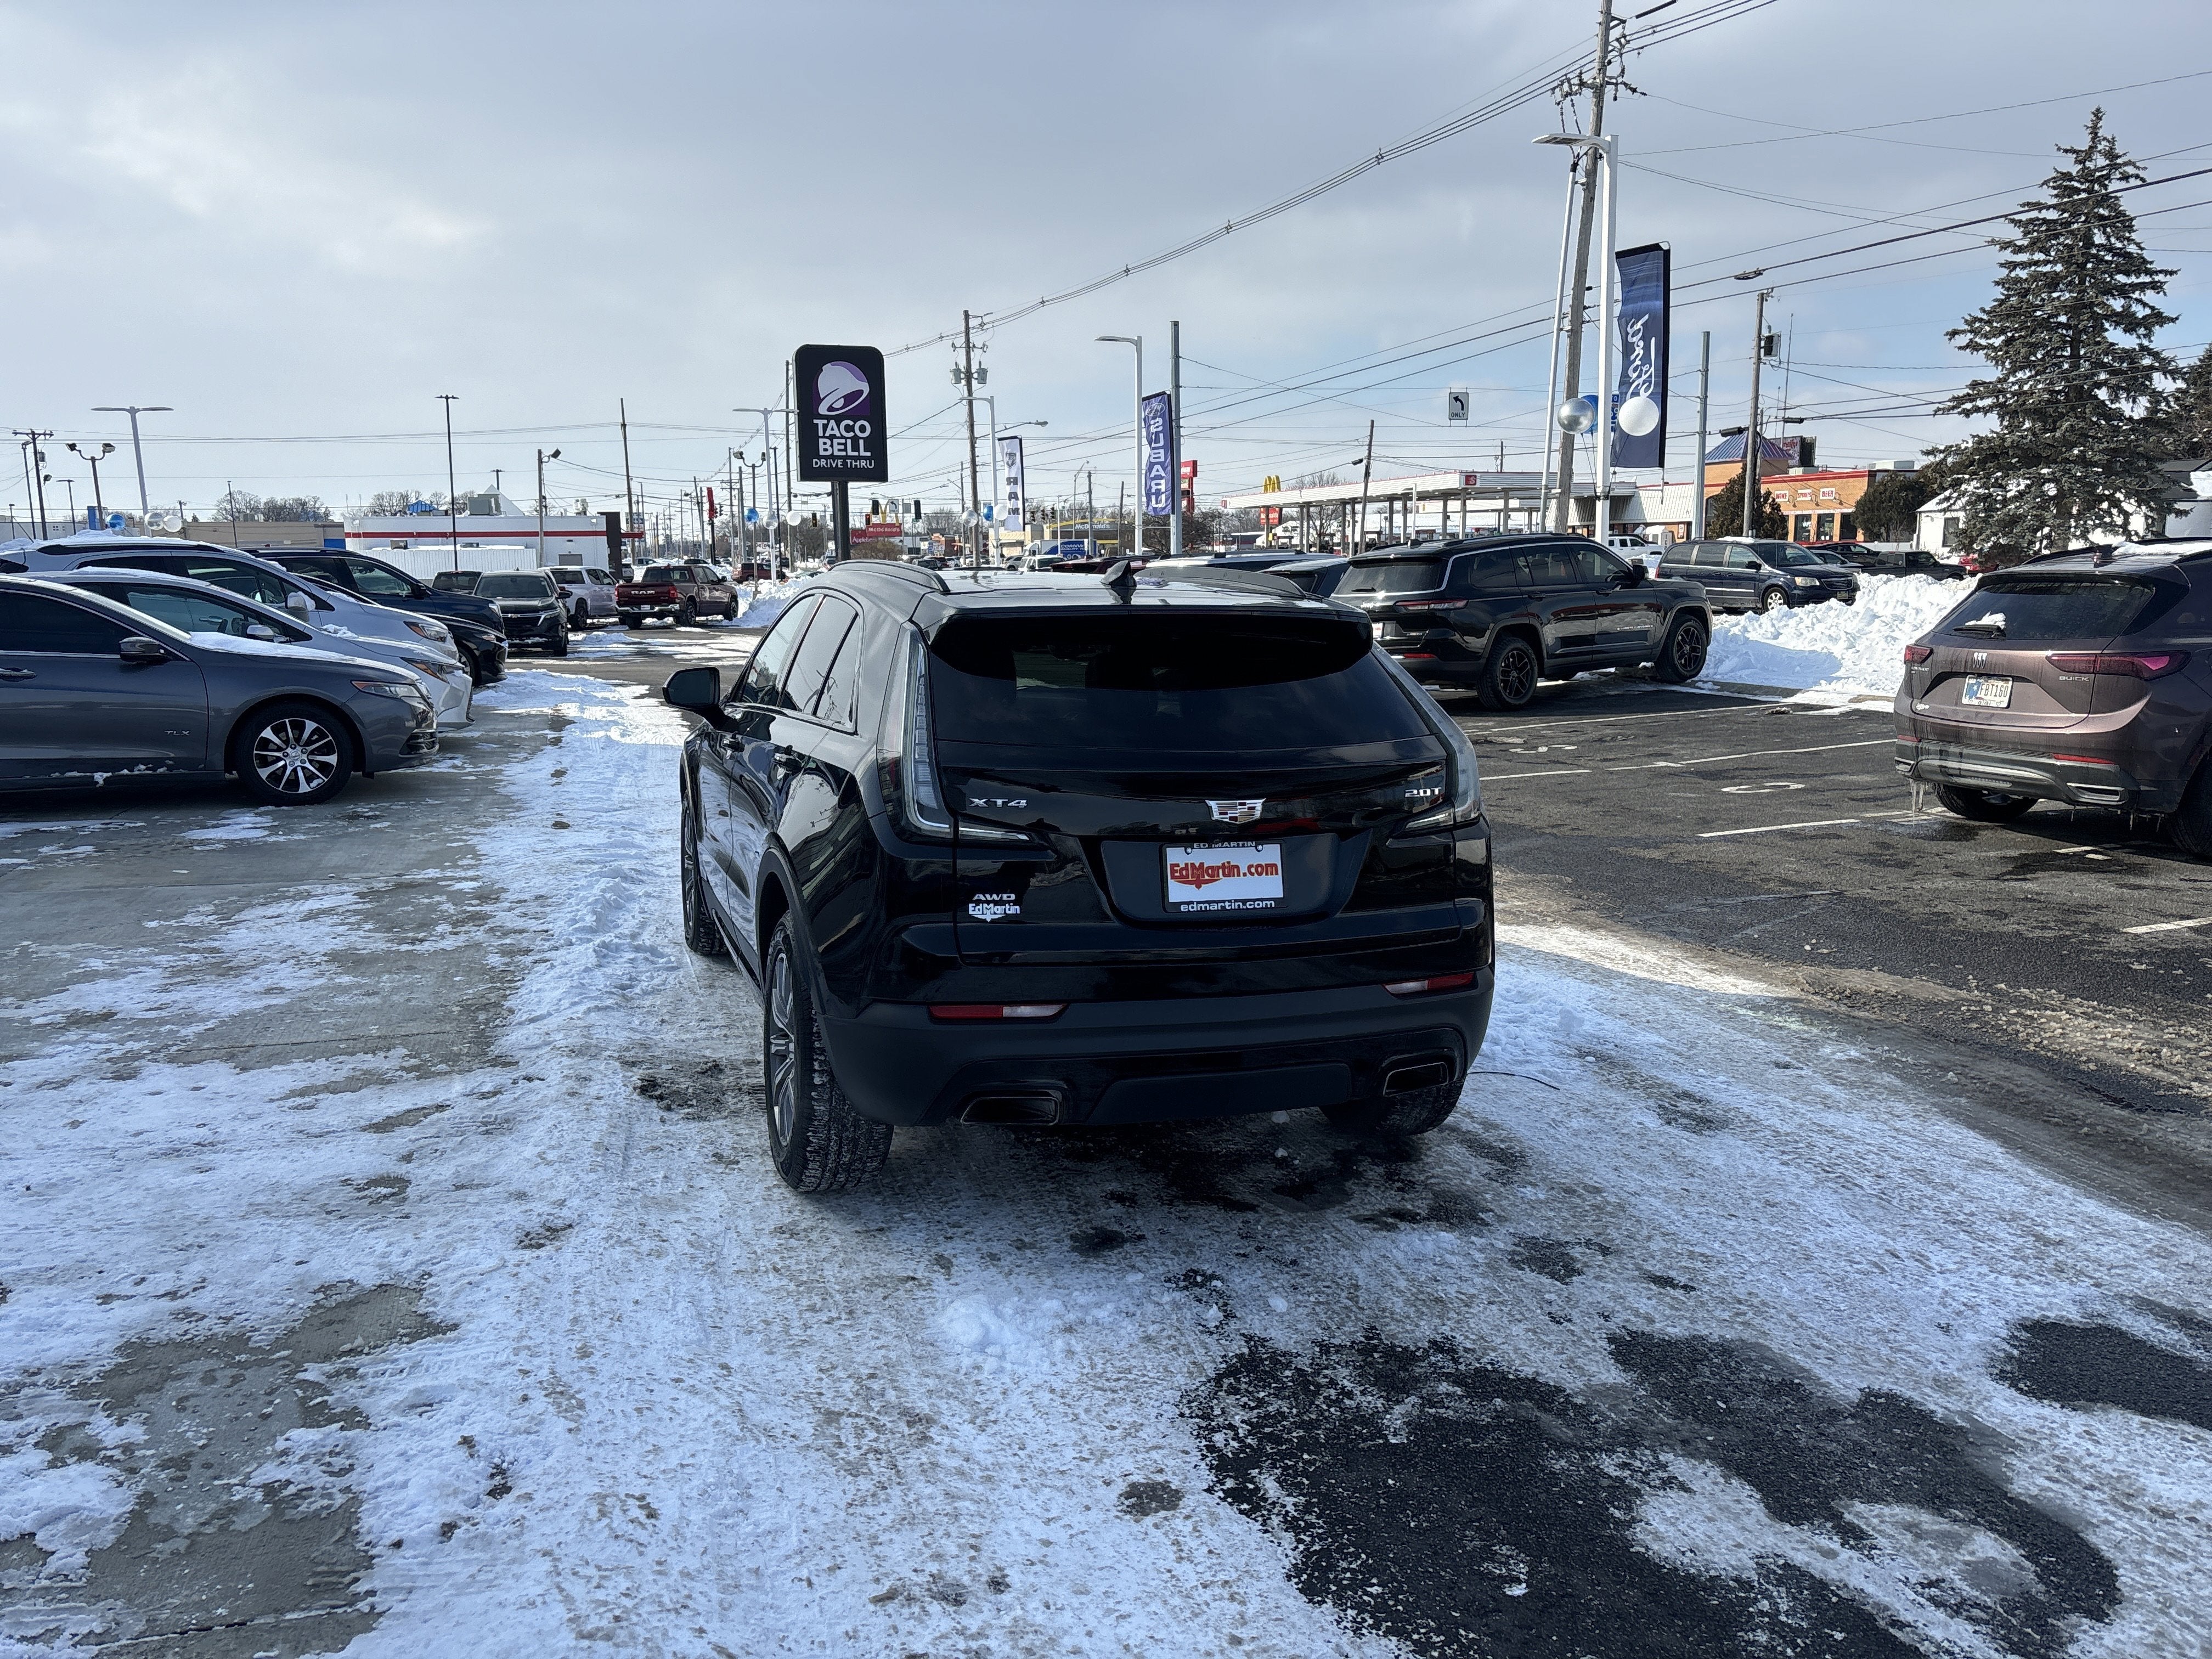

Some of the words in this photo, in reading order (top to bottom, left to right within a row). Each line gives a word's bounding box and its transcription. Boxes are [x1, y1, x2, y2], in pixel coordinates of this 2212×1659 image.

[812, 419, 871, 438] TACO
[819, 438, 871, 456] BELL
[812, 459, 844, 468] DRIVE
[845, 459, 874, 469] THRU
[1979, 683, 2009, 698] FBT160
[969, 798, 1028, 808] XT4
[1169, 860, 1279, 880] EdMartin.com
[968, 903, 1020, 915] EdMartin
[1180, 900, 1276, 912] edmartin.com
